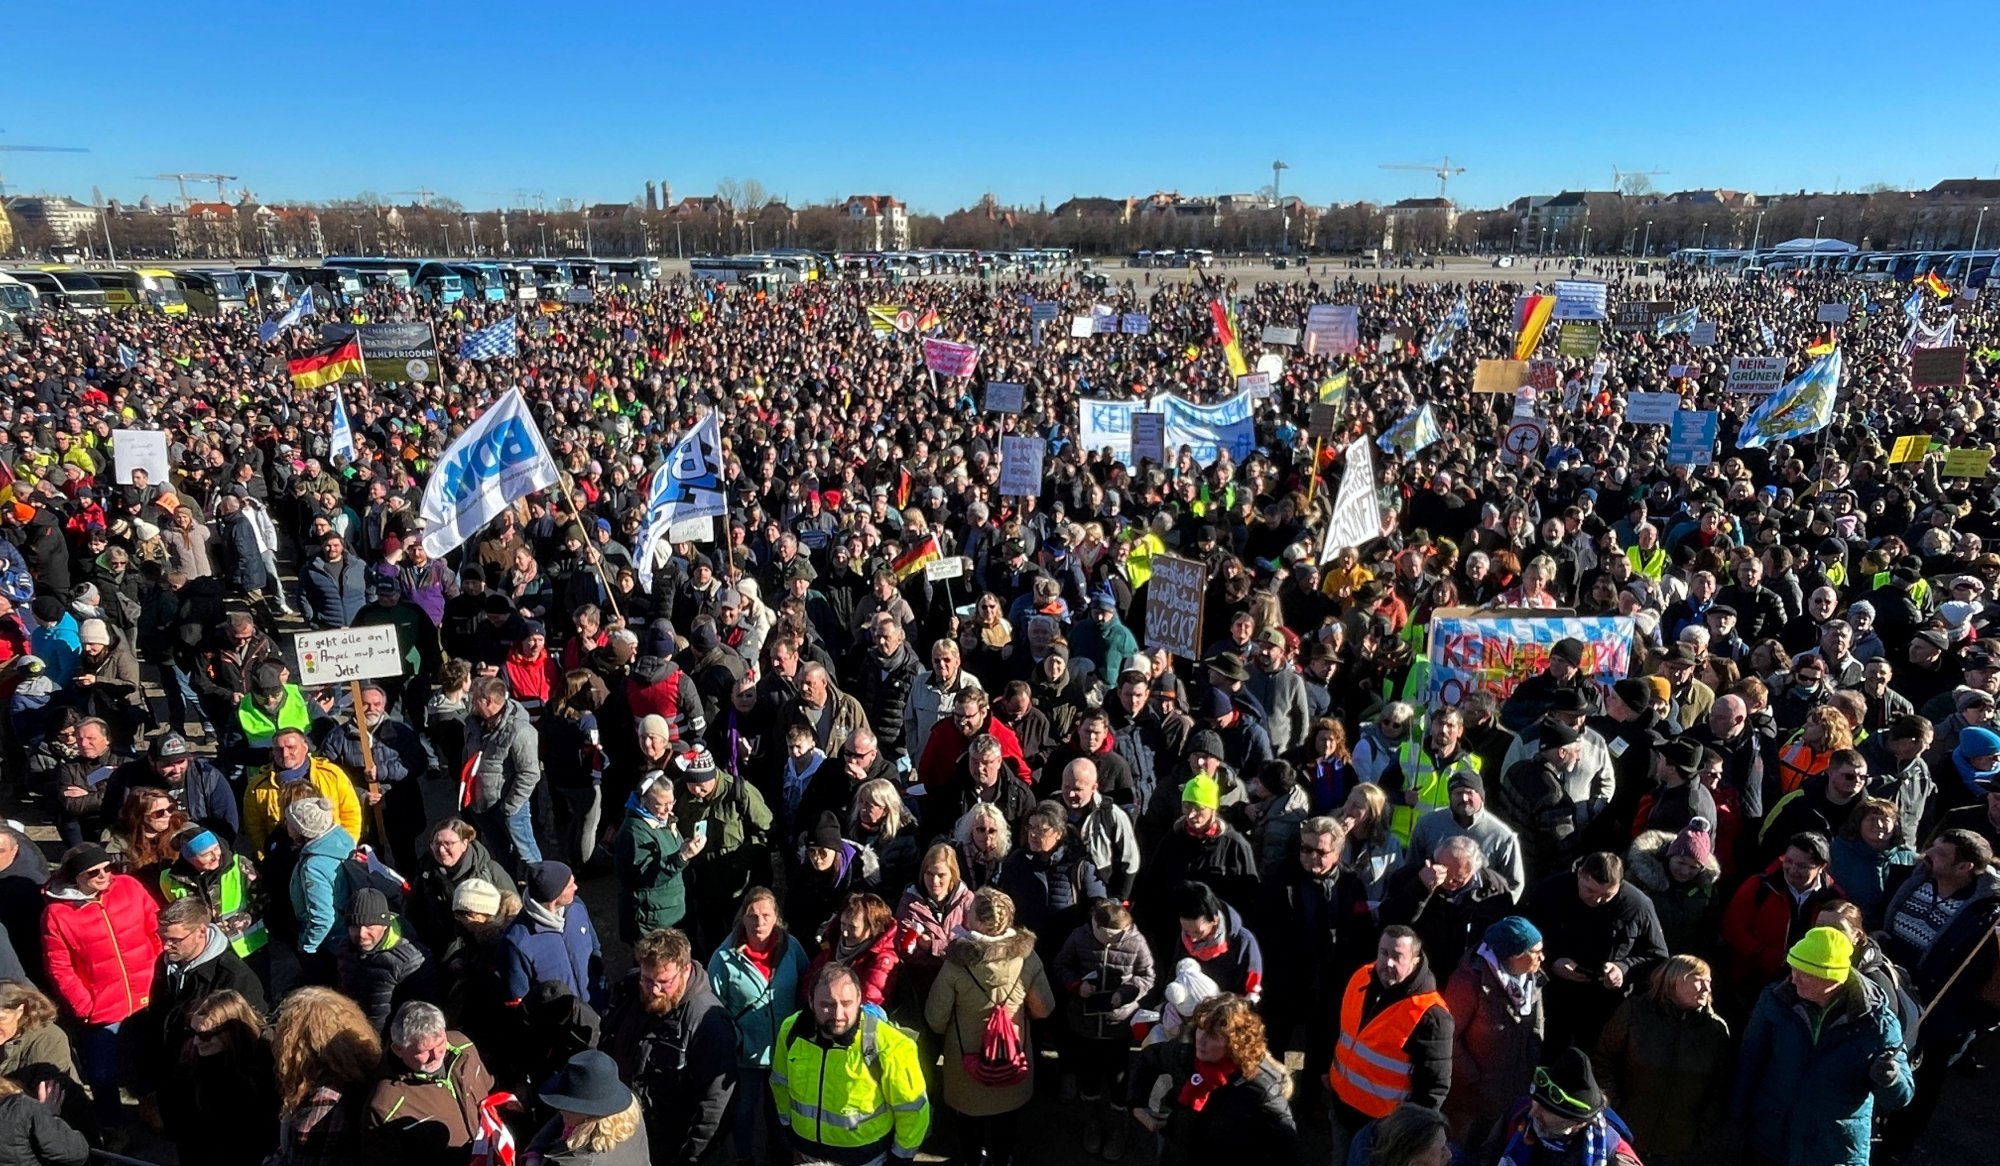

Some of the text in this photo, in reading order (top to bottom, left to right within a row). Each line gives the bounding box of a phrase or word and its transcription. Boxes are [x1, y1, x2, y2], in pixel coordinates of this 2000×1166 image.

[1630, 303, 1650, 313] VIEL
[1622, 313, 1637, 323] IST
[1737, 360, 1766, 369] NEIN
[1731, 370, 1781, 381] GRÜNEN
[297, 636, 309, 649] Es
[315, 634, 338, 649] geht
[320, 649, 349, 663] Ampel
[1443, 633, 1514, 670] KEIN
[335, 663, 360, 678] Jetzt
